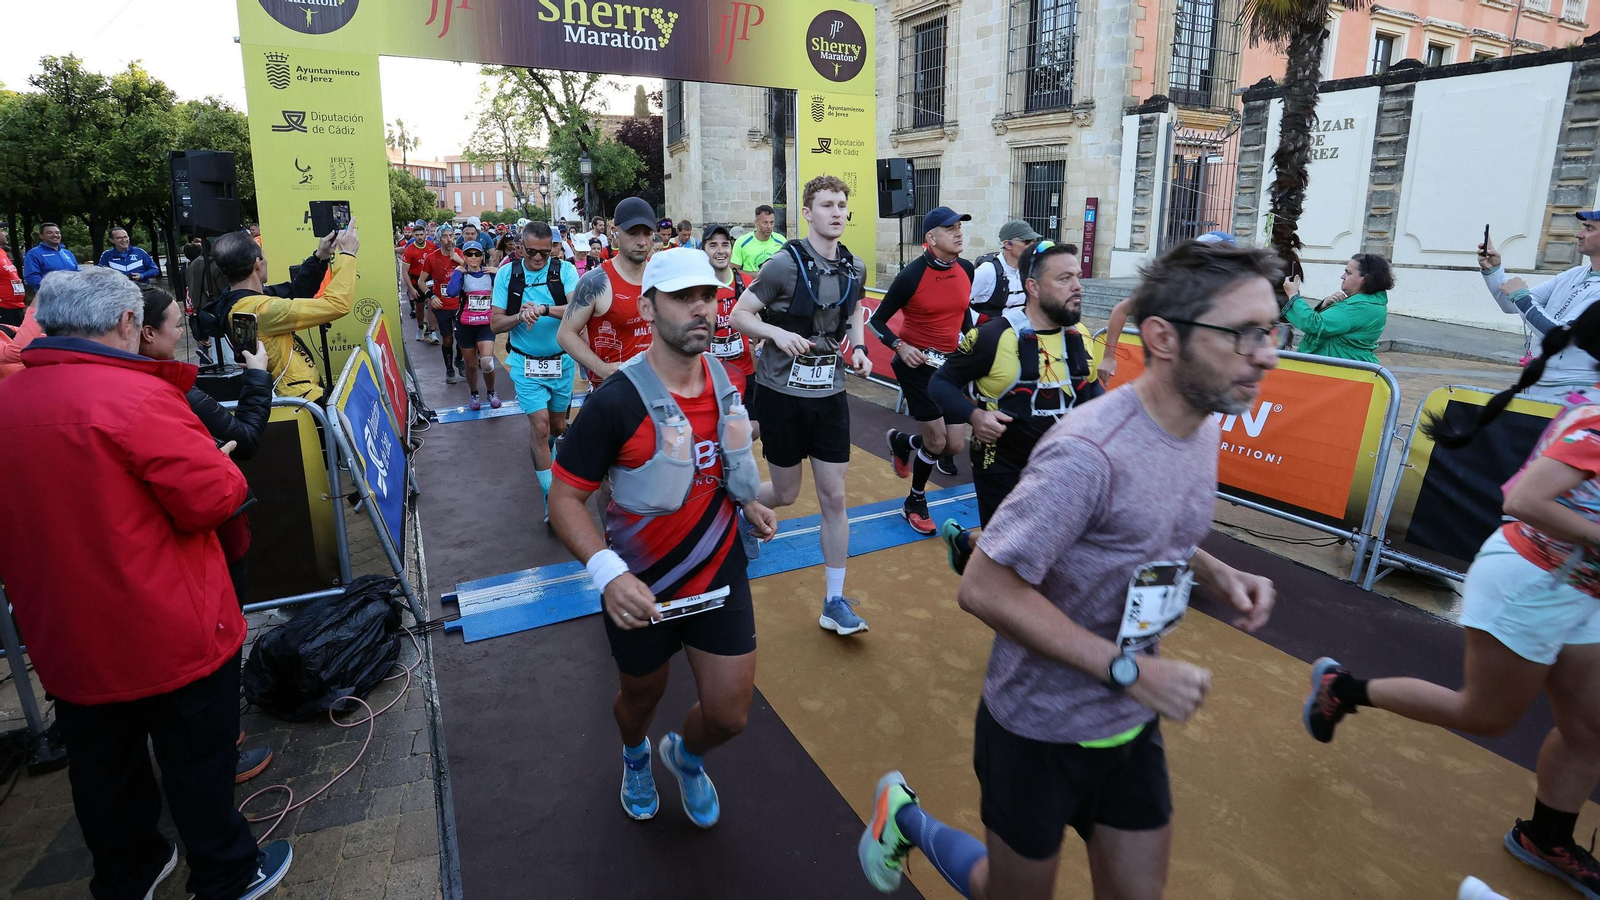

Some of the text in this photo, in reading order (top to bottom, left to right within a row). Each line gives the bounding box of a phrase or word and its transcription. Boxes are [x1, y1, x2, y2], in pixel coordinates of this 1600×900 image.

[537, 0, 679, 48] Sherry
[563, 25, 659, 52] Maratón
[811, 36, 862, 61] Sherry
[820, 51, 854, 62] Maratón
[296, 65, 360, 77] Ayuntamiento
[296, 74, 334, 83] de Jerez
[827, 104, 865, 113] Ayuntamiento
[310, 111, 364, 123] Diputación
[312, 124, 356, 135] de Cádiz
[1311, 117, 1355, 132] AZAR
[833, 137, 865, 147] Diputación
[843, 147, 859, 156] Cádiz
[1309, 147, 1339, 160] REZ
[355, 299, 380, 313] VALDESPIN
[538, 360, 549, 370] 55
[810, 366, 822, 379] 10
